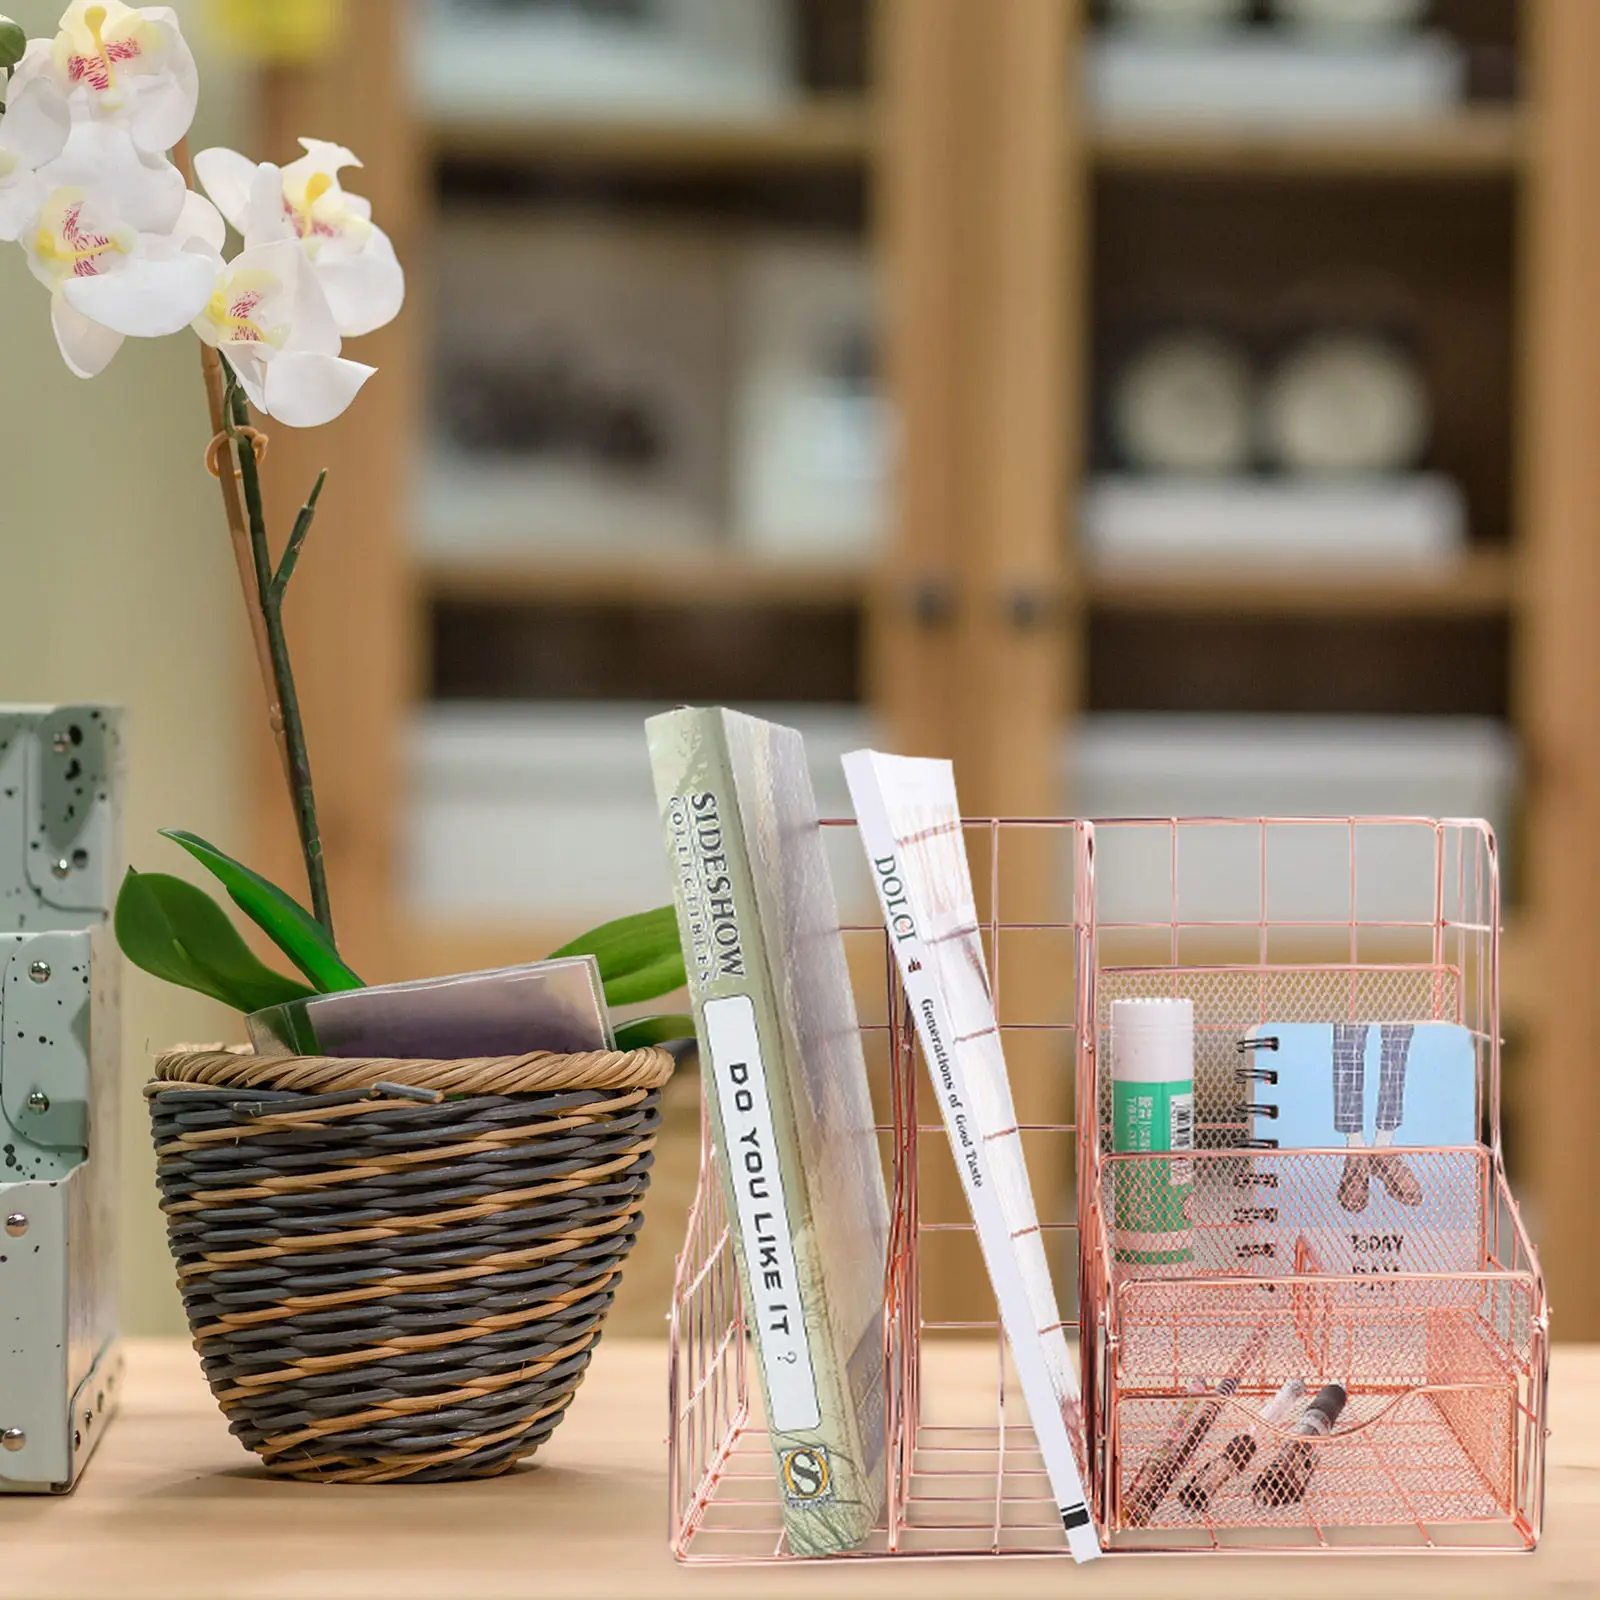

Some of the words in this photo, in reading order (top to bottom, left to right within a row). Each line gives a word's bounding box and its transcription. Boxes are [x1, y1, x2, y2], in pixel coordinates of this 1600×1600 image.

[691, 791, 744, 979] SIDESHOW
[874, 854, 918, 943] DOLCI
[921, 998, 956, 1091] Generations
[729, 1062, 753, 1112] DO
[948, 1094, 963, 1109] of
[955, 1113, 974, 1148] Good
[740, 1127, 769, 1199] YOU
[965, 1149, 983, 1188] Taste
[754, 1212, 783, 1290] LIKE
[768, 1304, 790, 1336] IT
